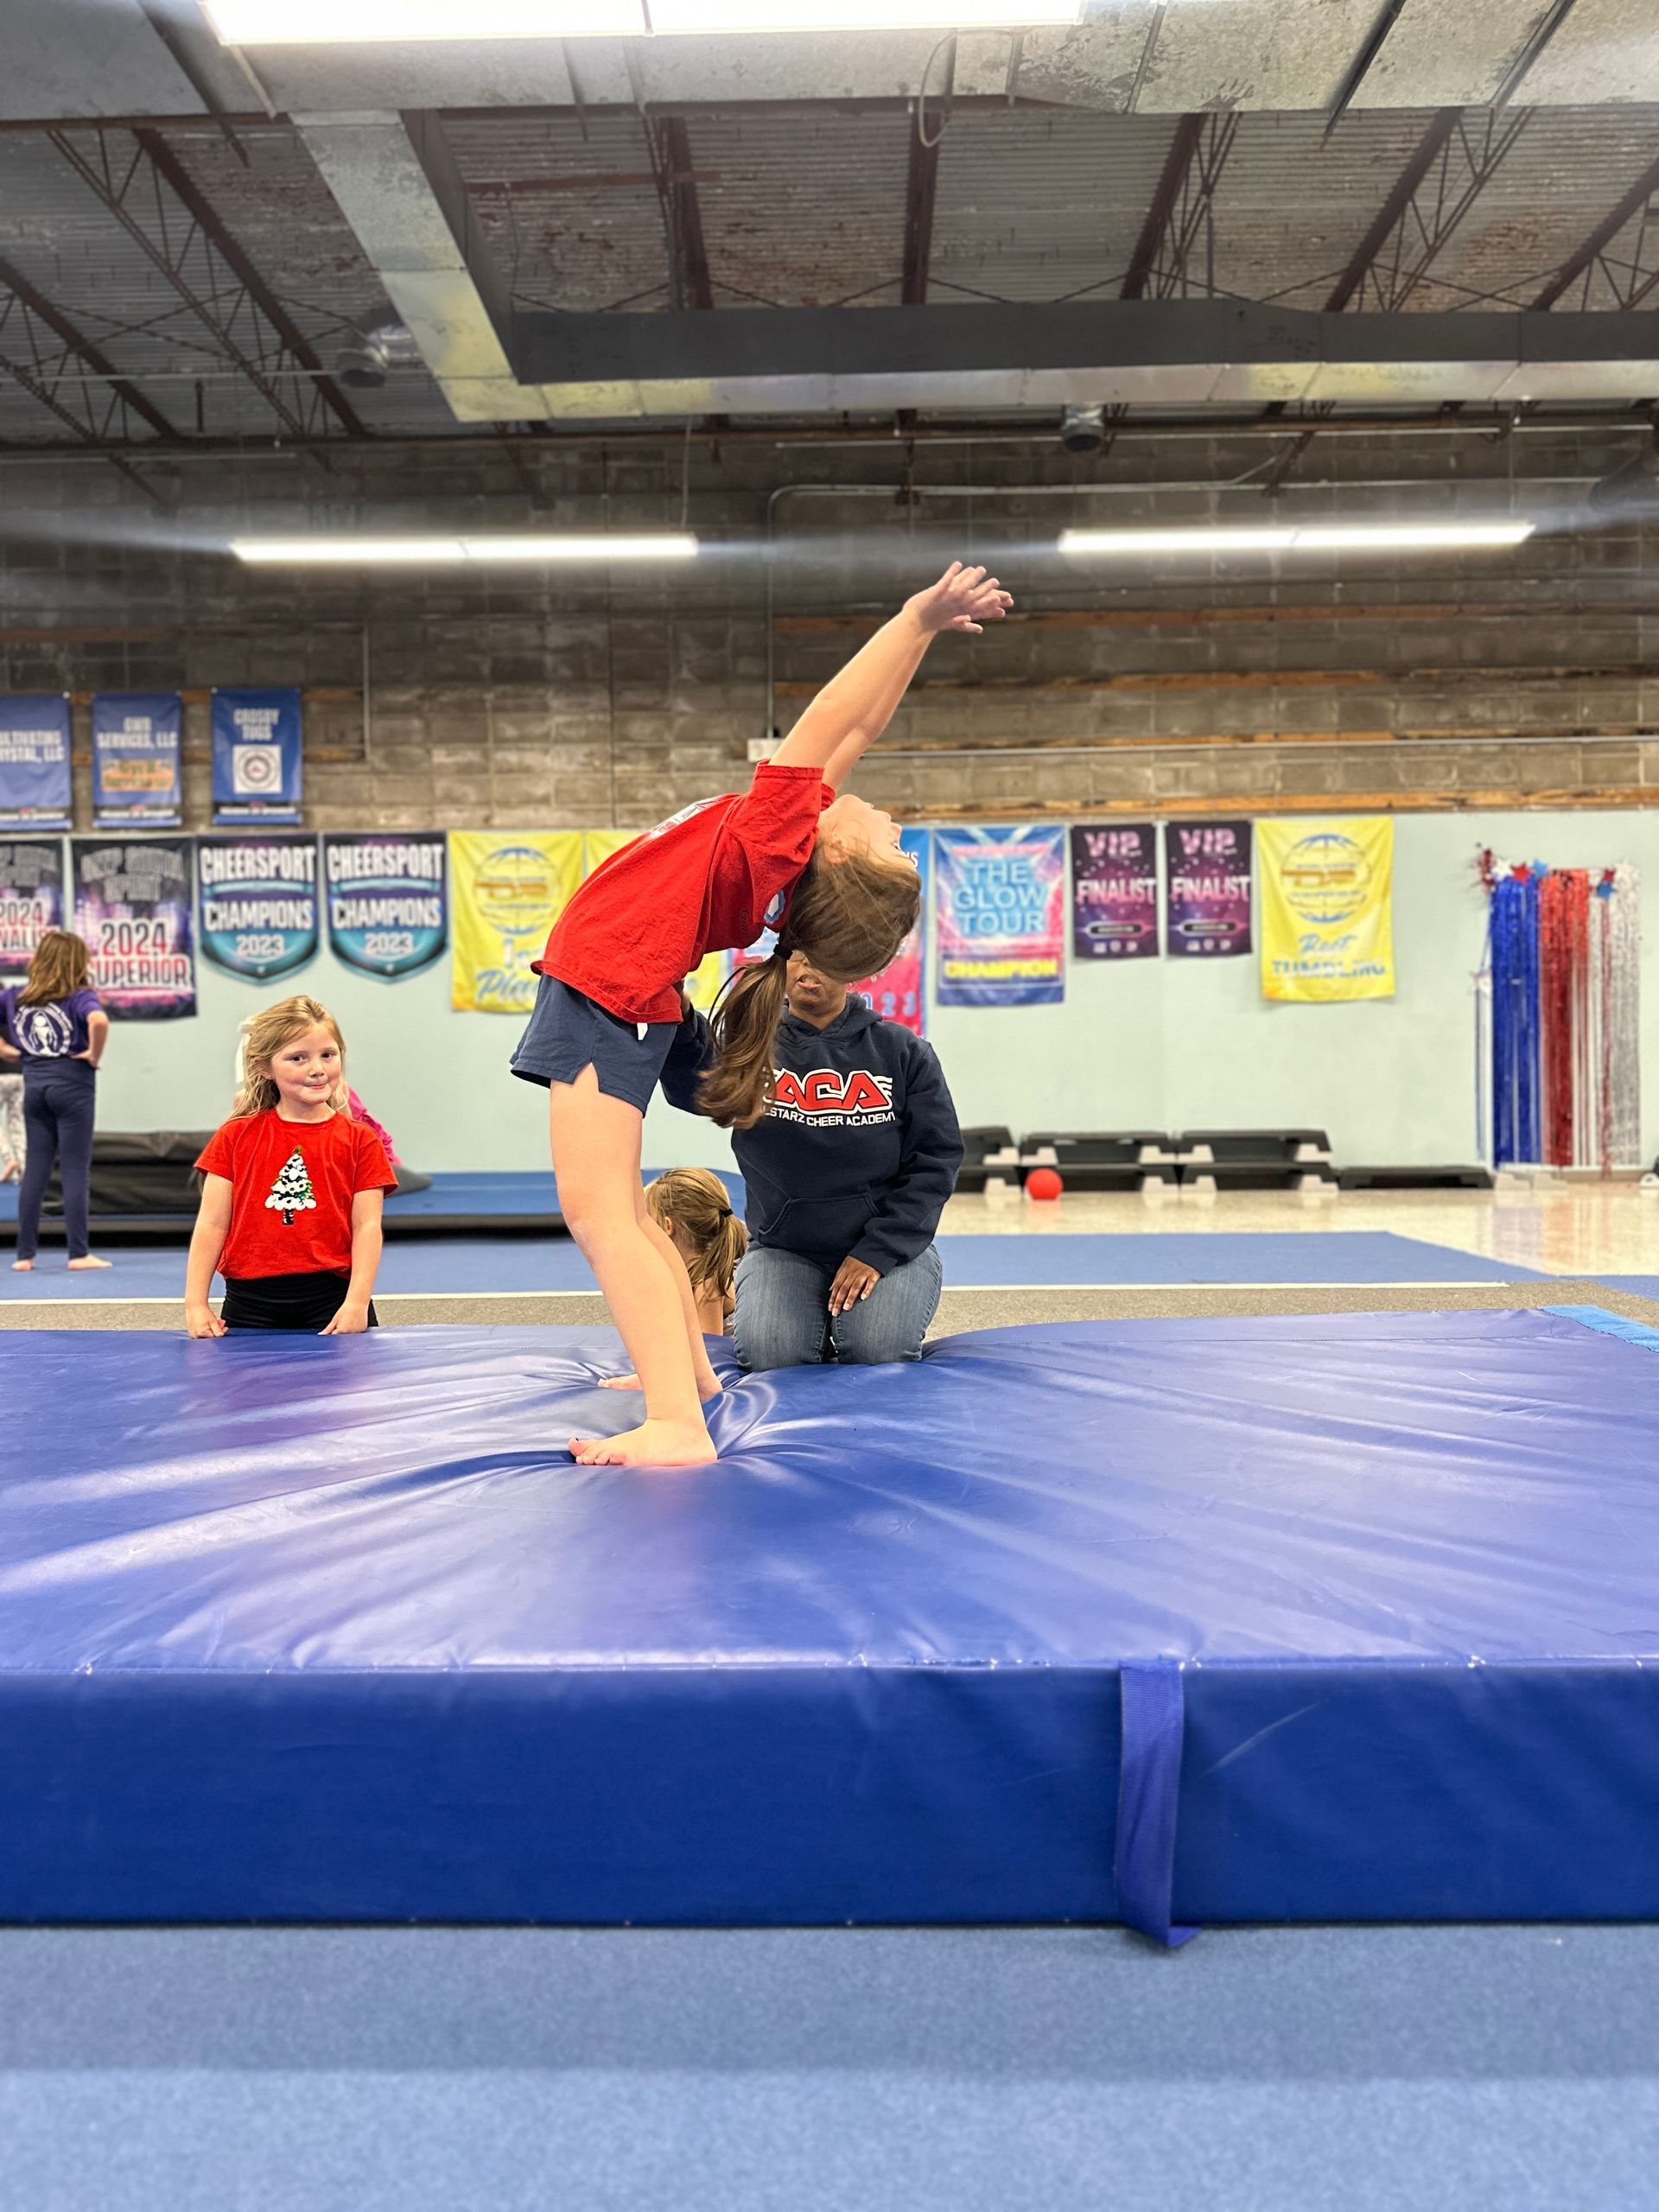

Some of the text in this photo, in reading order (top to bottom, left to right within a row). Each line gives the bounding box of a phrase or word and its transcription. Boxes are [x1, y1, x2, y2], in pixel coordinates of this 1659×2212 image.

[156, 731, 178, 749] LLC
[43, 746, 65, 762] LLC
[1084, 831, 1141, 857] VIP
[1179, 829, 1236, 855] VIP
[200, 845, 316, 885] CHEERSPORT
[327, 843, 444, 882] CHEERSPORT
[973, 862, 1030, 885] THE
[954, 885, 1047, 909] GLOW
[1076, 877, 1157, 905] FINALIST
[1170, 875, 1251, 902] FINALIST
[205, 899, 314, 931] CHAMPIONS
[333, 898, 442, 930] CHAMPIONS
[957, 911, 1046, 934] TOUR
[100, 921, 168, 957] 2024
[236, 934, 284, 957] 2023
[364, 932, 414, 955] 2023
[87, 957, 188, 988] SUPERIOR
[805, 1116, 844, 1128] CHEER
